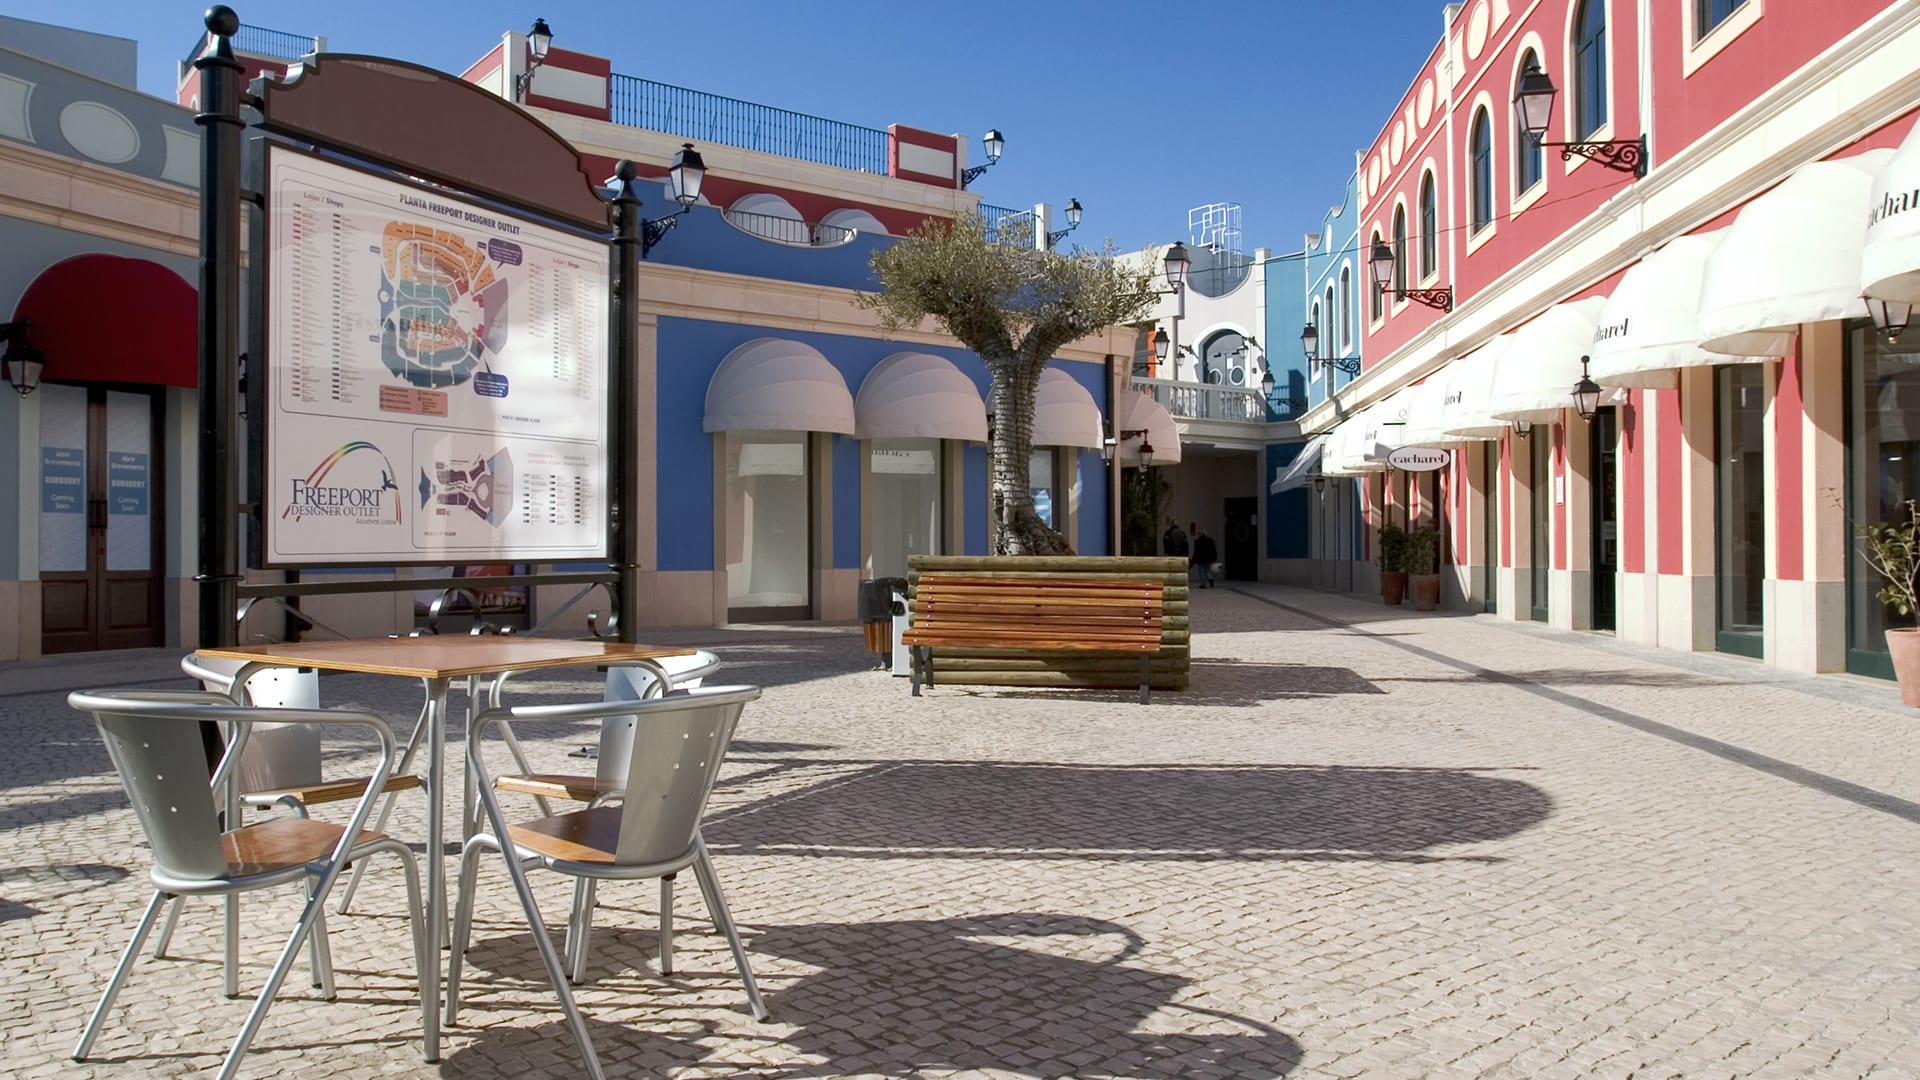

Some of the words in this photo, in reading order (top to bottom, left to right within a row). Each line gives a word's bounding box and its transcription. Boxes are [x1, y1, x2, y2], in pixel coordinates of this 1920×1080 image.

[400, 194, 427, 210] PLANTA
[429, 202, 463, 220] FREEPORT
[465, 212, 496, 229] DESIGNER
[497, 222, 520, 235] OUTLET
[1393, 454, 1444, 464] cacharel
[291, 479, 383, 510] FREEPORT
[291, 505, 341, 516] DESIGNER
[343, 507, 381, 517] OUTLET
